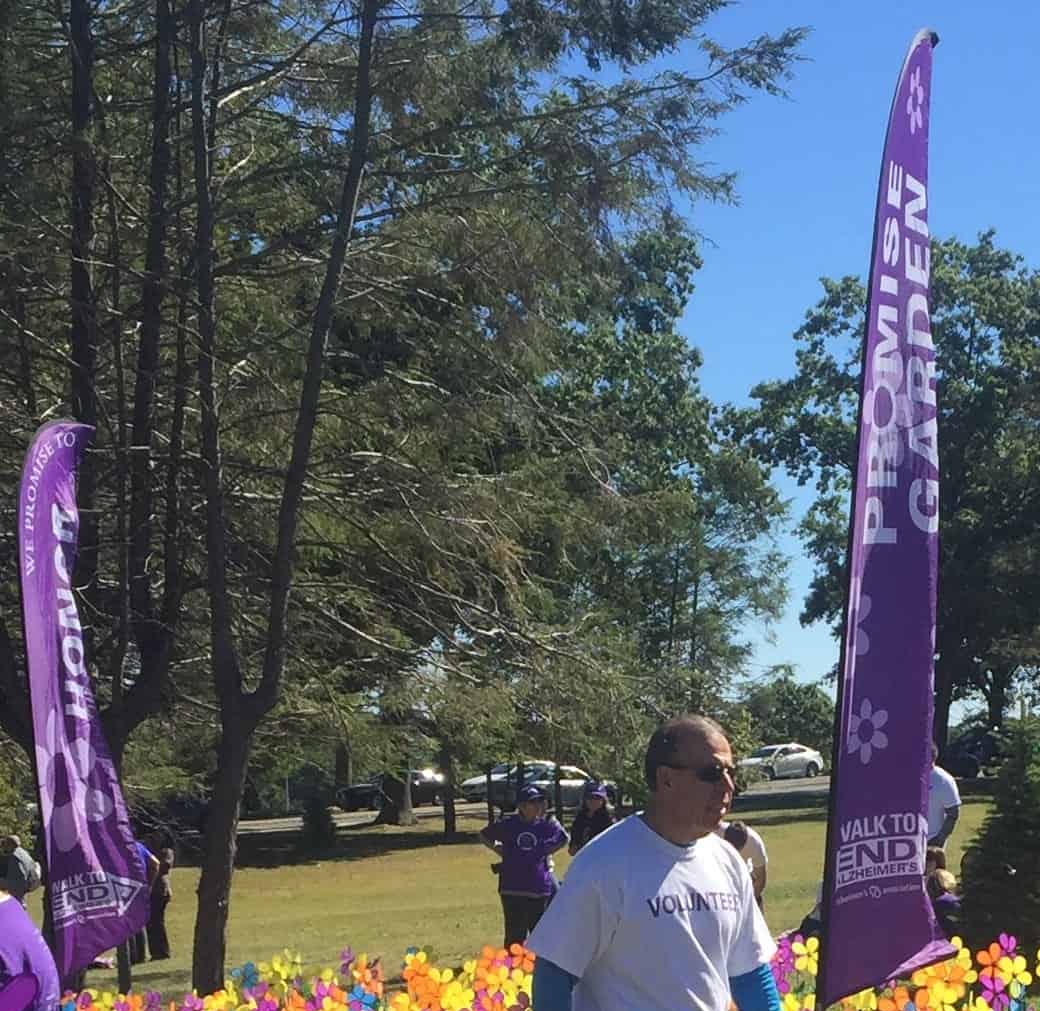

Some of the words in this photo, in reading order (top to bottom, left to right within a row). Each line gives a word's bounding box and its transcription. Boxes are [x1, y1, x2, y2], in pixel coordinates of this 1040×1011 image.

[863, 160, 903, 545] PROMISE
[904, 173, 939, 533] GARDEN
[55, 431, 76, 449] TO
[24, 440, 55, 532] PROMISE
[25, 539, 36, 576] WE
[890, 812, 916, 833] TO
[839, 838, 917, 872] END
[86, 871, 106, 883] TO
[840, 862, 918, 885] LZHEIMER'S
[53, 886, 109, 911] END
